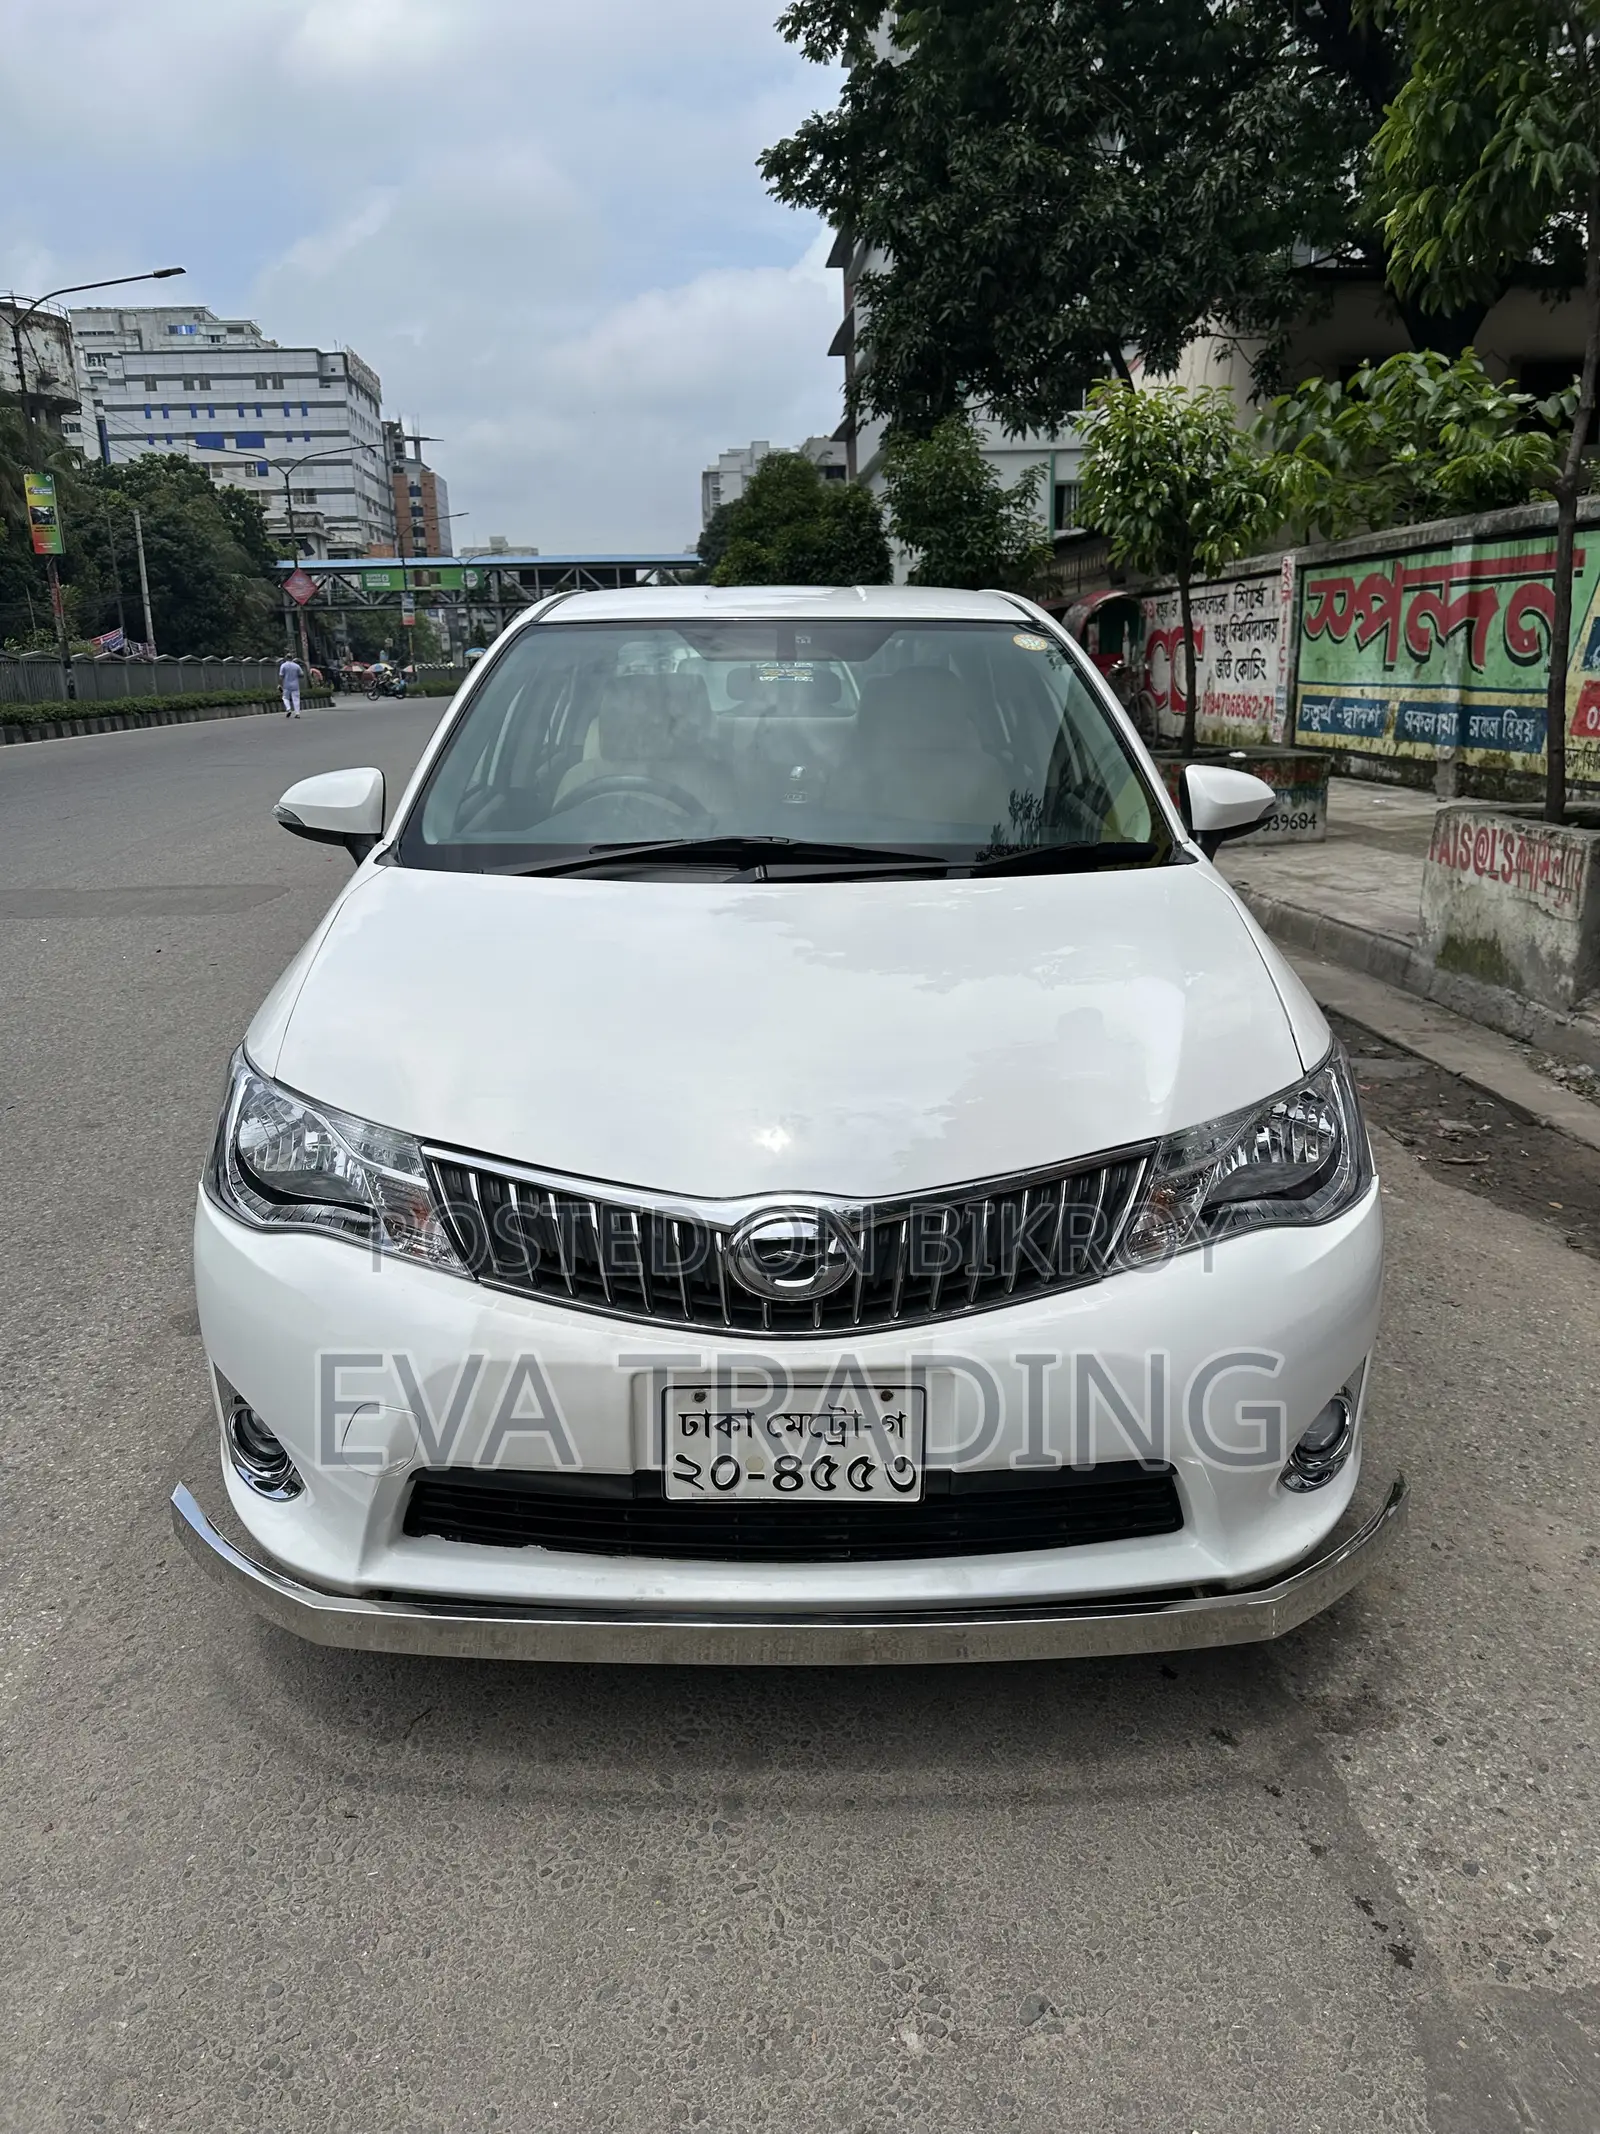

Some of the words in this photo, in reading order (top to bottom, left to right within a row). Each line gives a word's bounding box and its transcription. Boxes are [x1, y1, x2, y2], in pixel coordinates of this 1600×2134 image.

[1235, 648, 1267, 684] কোচিং
[677, 1409, 756, 1439] ঢাকা
[672, 1453, 917, 1493] ২০-৪৫৫৩
